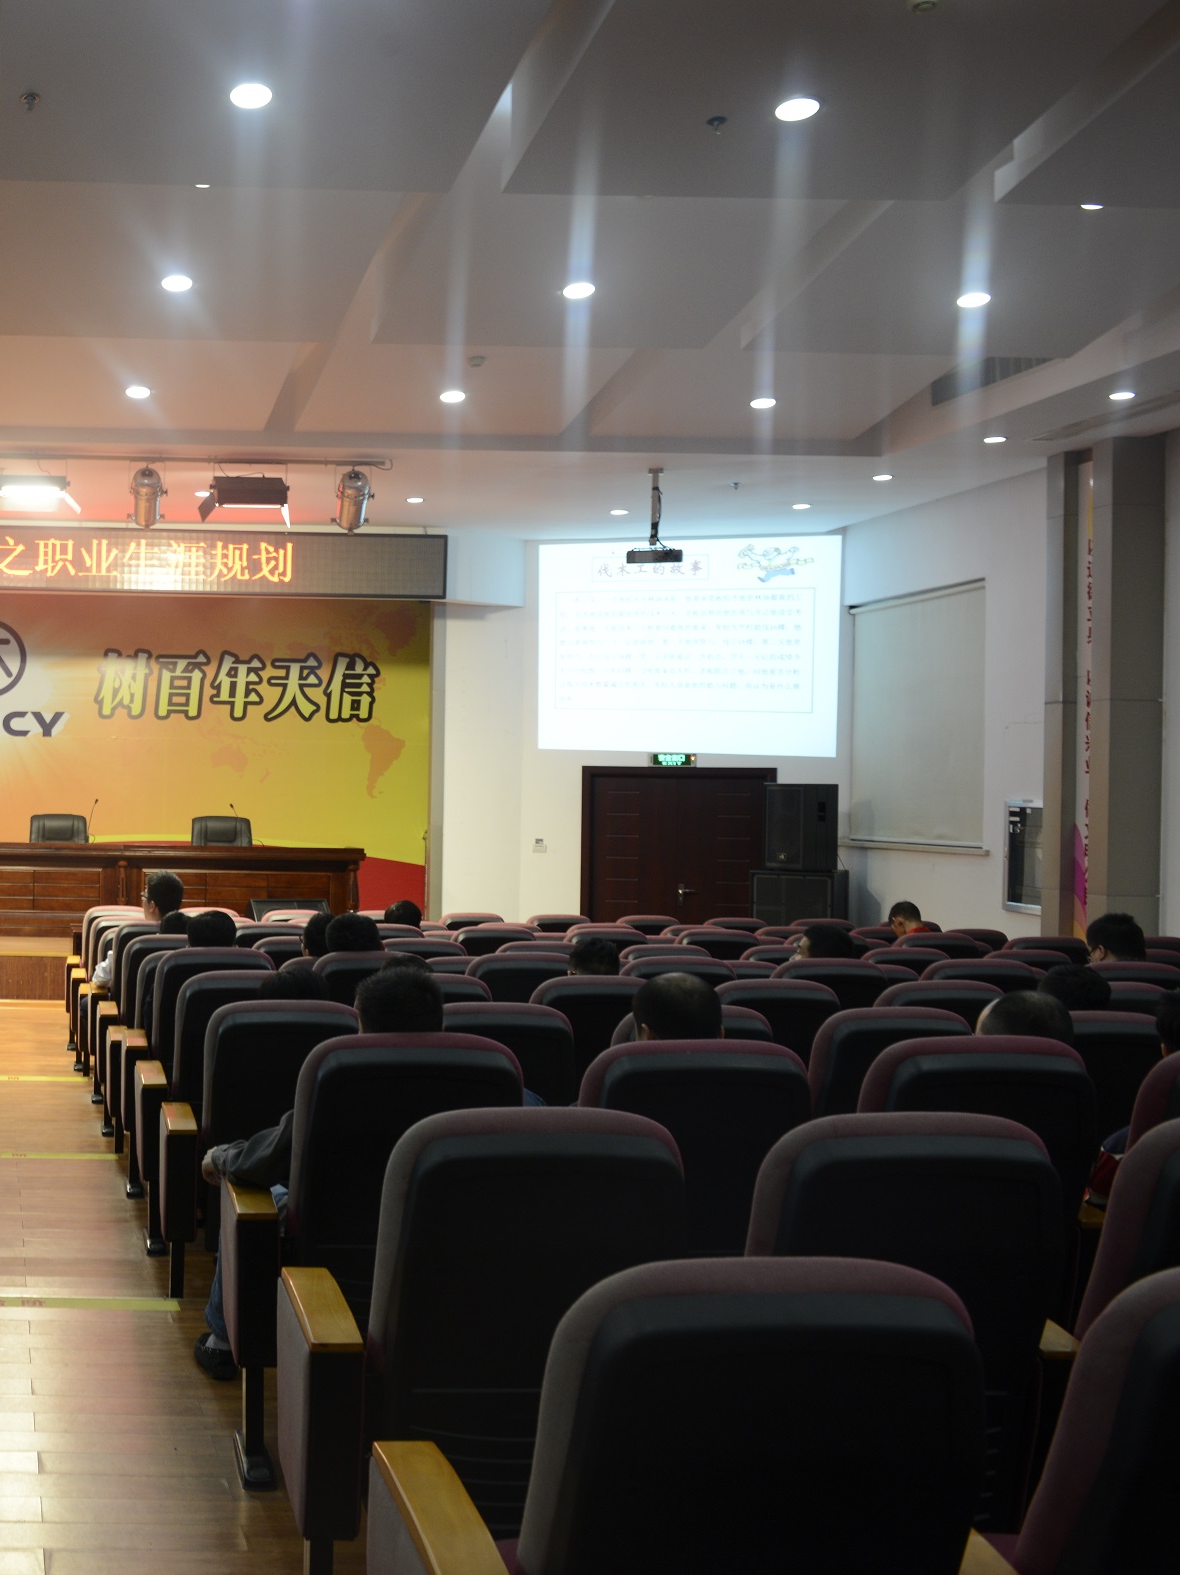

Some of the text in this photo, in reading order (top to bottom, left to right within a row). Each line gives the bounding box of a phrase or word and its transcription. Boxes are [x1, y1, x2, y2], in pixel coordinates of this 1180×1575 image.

[597, 560, 703, 578] 伐木工的故事
[96, 649, 380, 723] 树百年天信
